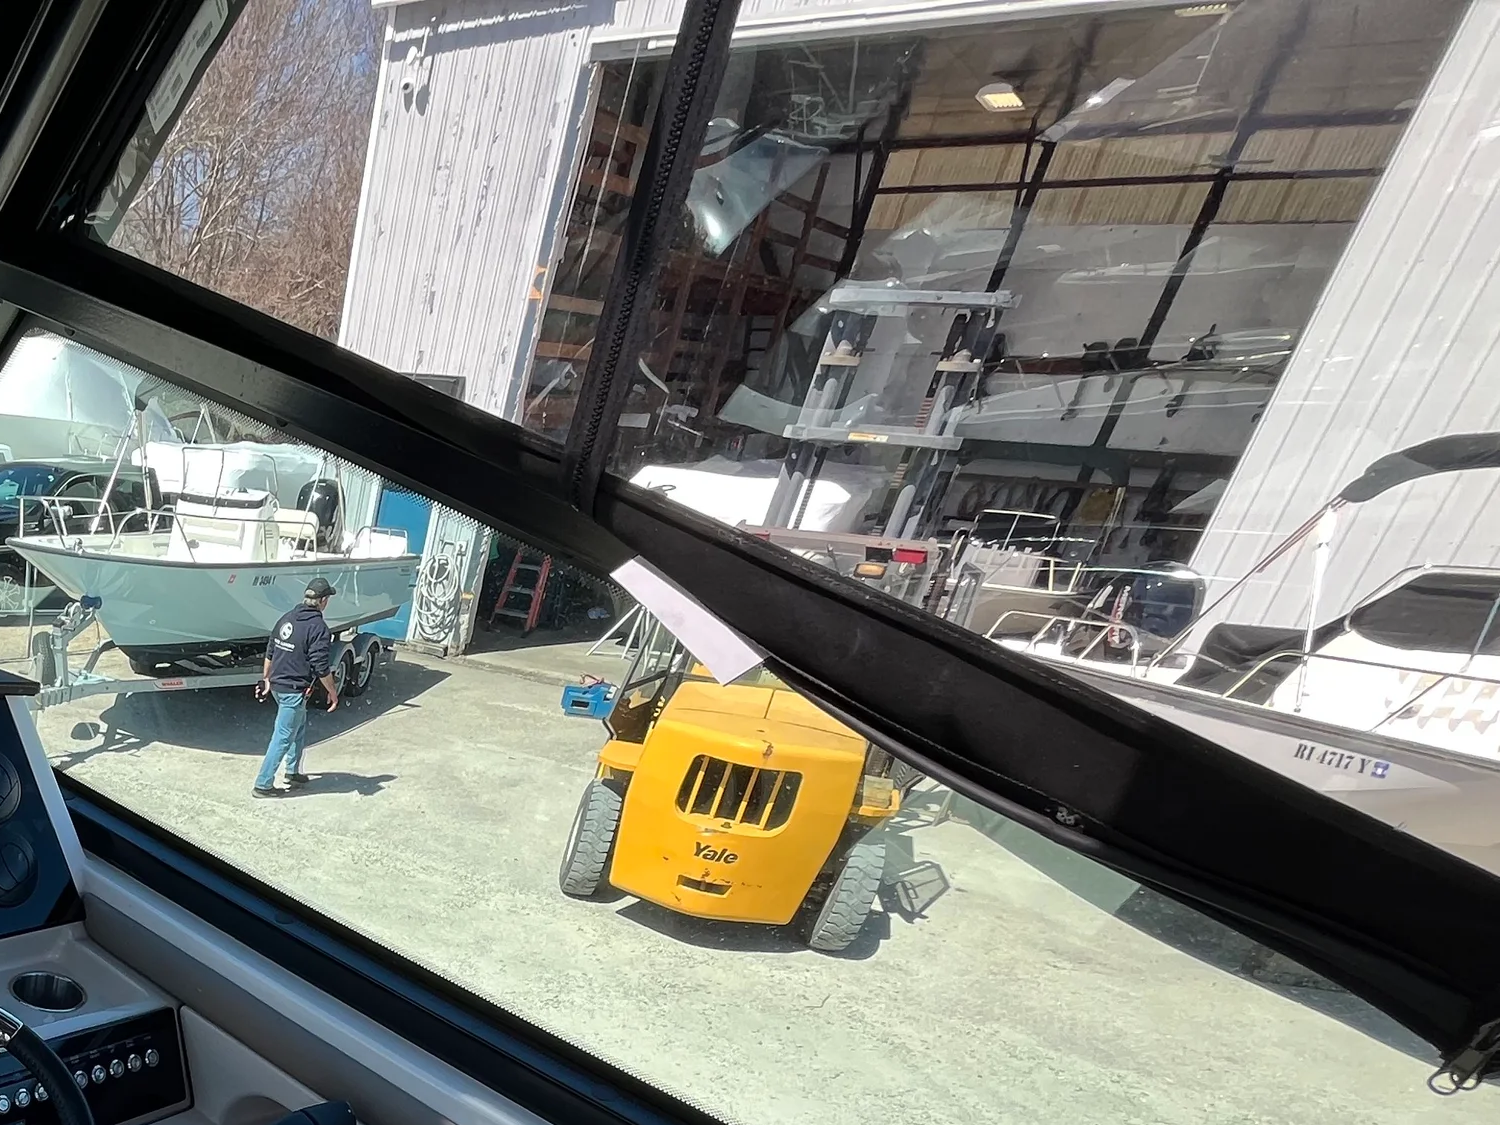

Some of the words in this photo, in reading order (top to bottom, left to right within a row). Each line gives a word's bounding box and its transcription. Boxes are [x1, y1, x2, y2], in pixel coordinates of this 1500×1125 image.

[1294, 743, 1316, 761] RI
[1358, 758, 1371, 774] Y
[693, 841, 739, 864] Yale
